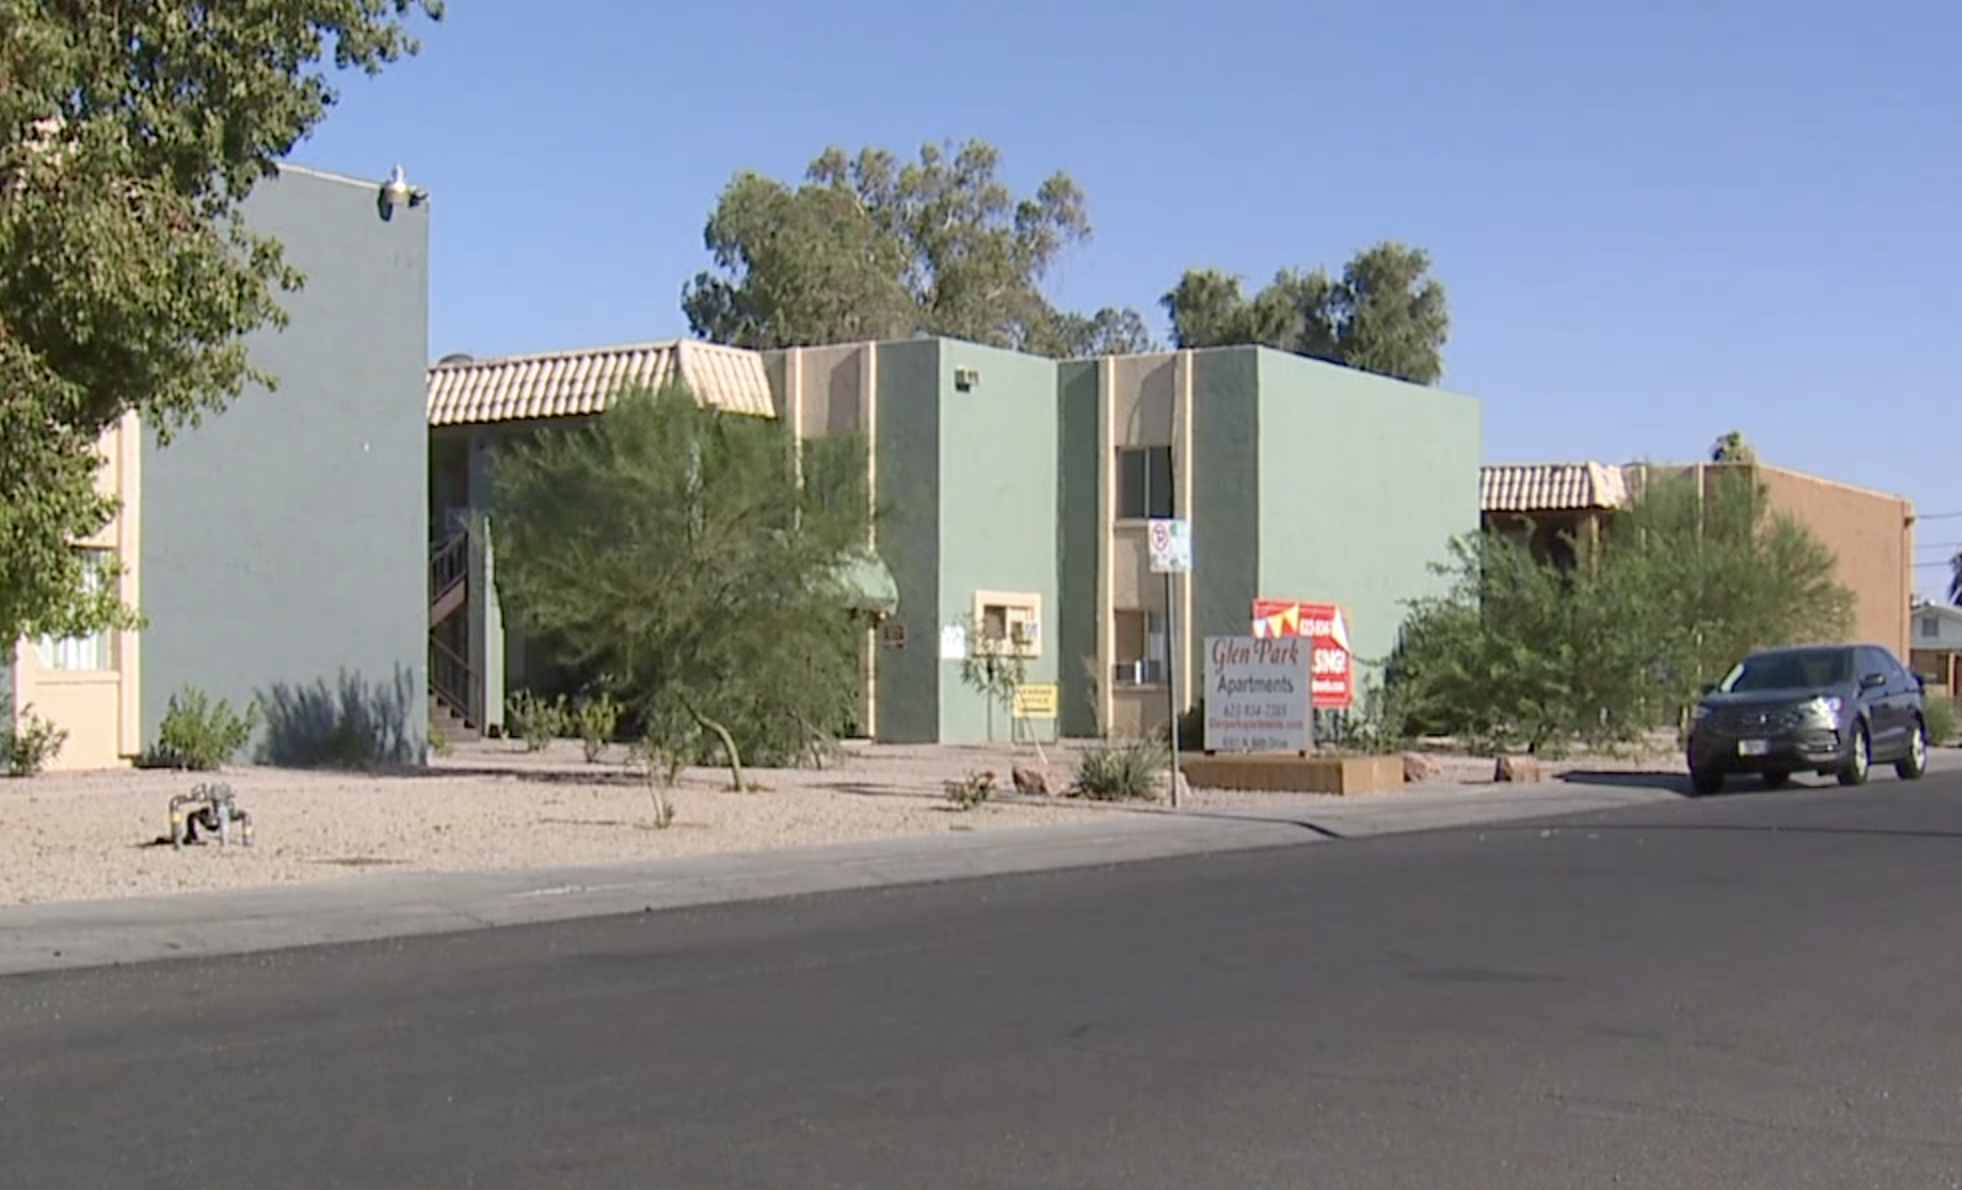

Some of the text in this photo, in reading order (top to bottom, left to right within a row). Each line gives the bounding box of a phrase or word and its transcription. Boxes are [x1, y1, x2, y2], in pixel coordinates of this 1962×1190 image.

[1212, 638, 1299, 675] Glen Park
[1217, 675, 1295, 696] Apartments
